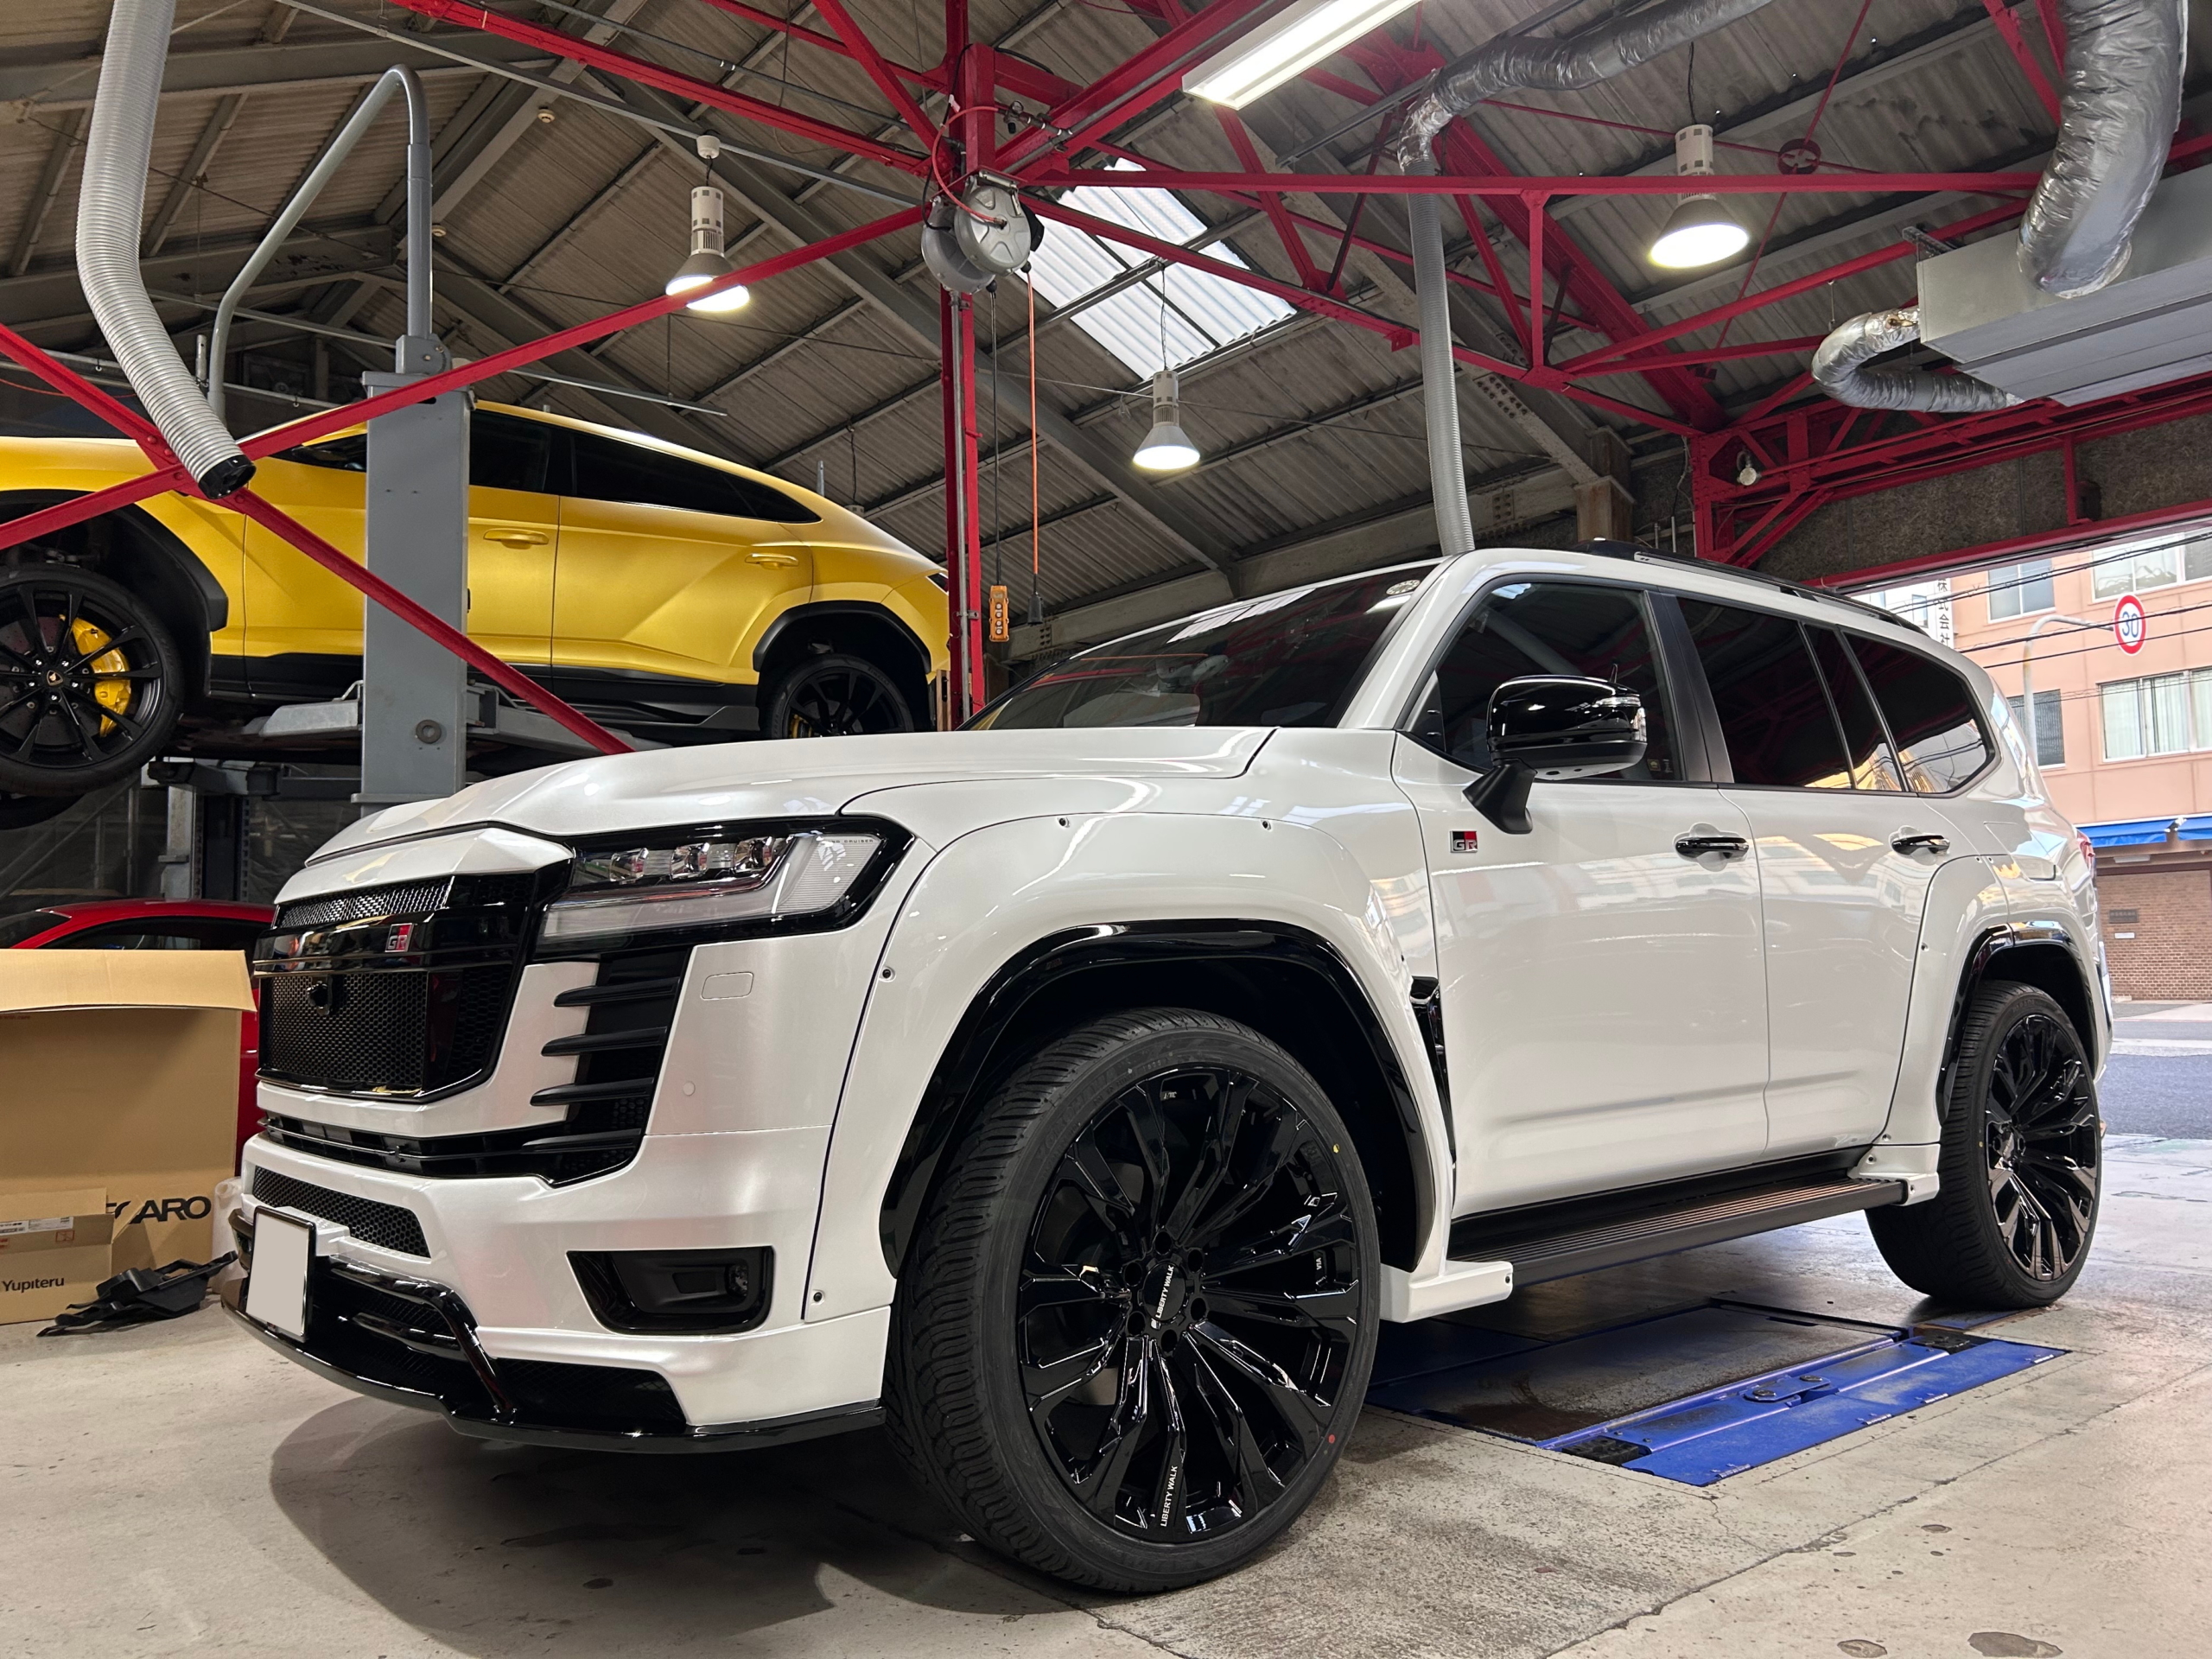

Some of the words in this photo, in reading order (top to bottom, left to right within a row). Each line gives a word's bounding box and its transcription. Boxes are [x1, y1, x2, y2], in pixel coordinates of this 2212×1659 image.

[2122, 611, 2139, 638] 30
[2, 1277, 65, 1294] Yupiteru
[1155, 1287, 1168, 1319] LIBERTY
[1163, 1264, 1174, 1287] WALK
[1166, 1465, 1179, 1491] WALK
[1160, 1491, 1173, 1528] LIBERTY
